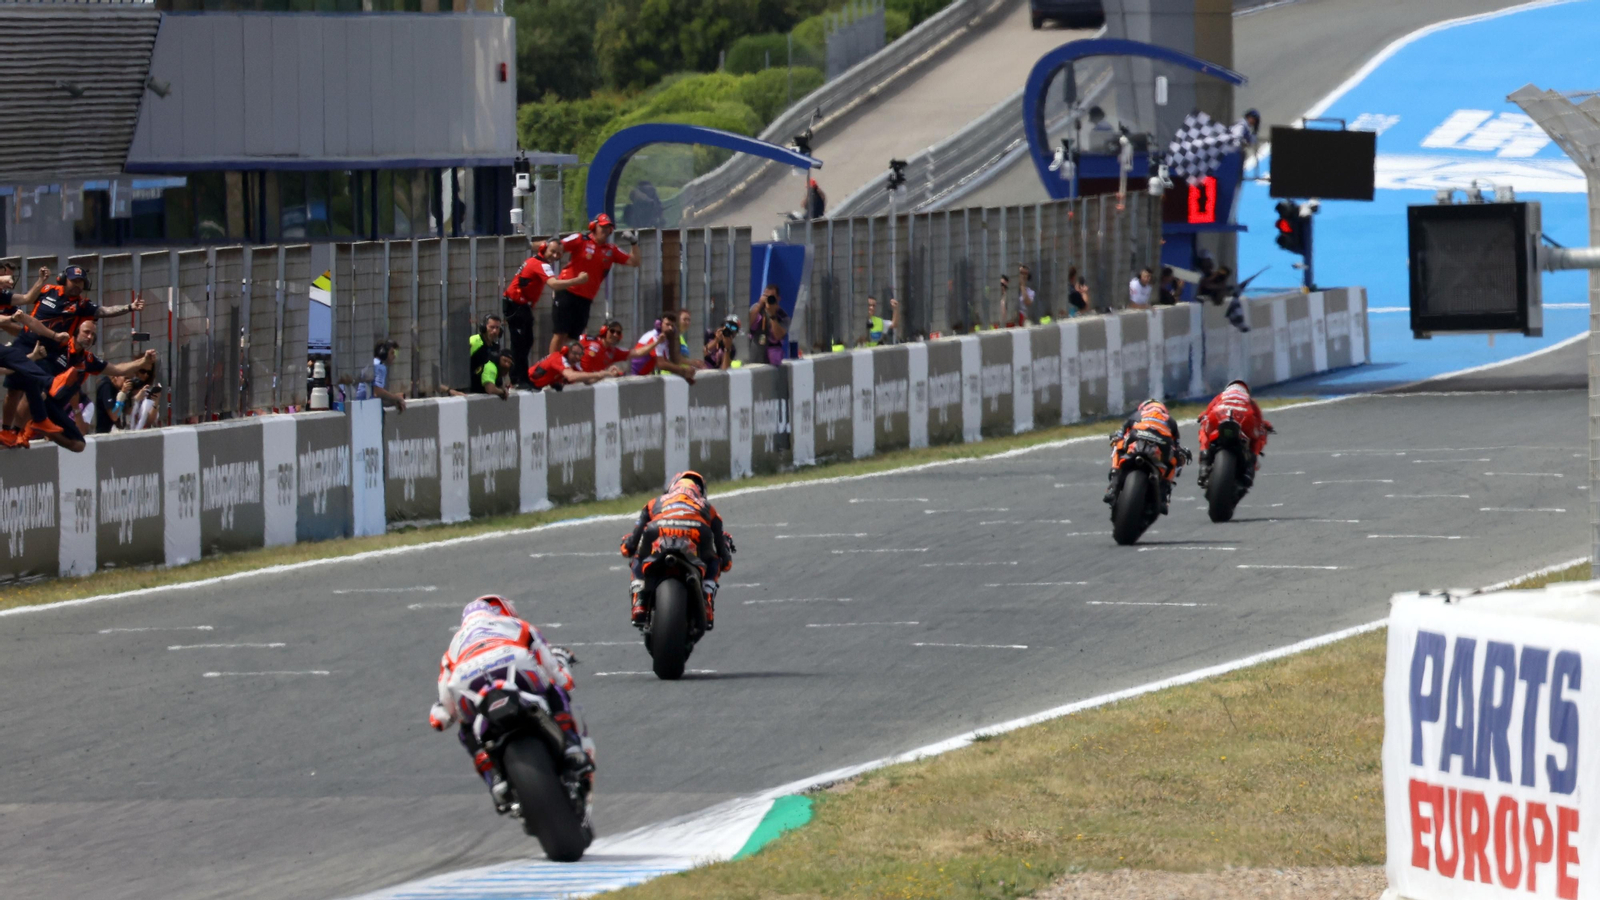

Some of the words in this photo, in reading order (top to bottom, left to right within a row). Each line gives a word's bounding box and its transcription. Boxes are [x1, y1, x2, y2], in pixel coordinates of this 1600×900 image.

[1188, 175, 1217, 224] 0
[1409, 629, 1582, 796] PARTS
[1408, 777, 1581, 900] EUROPE
